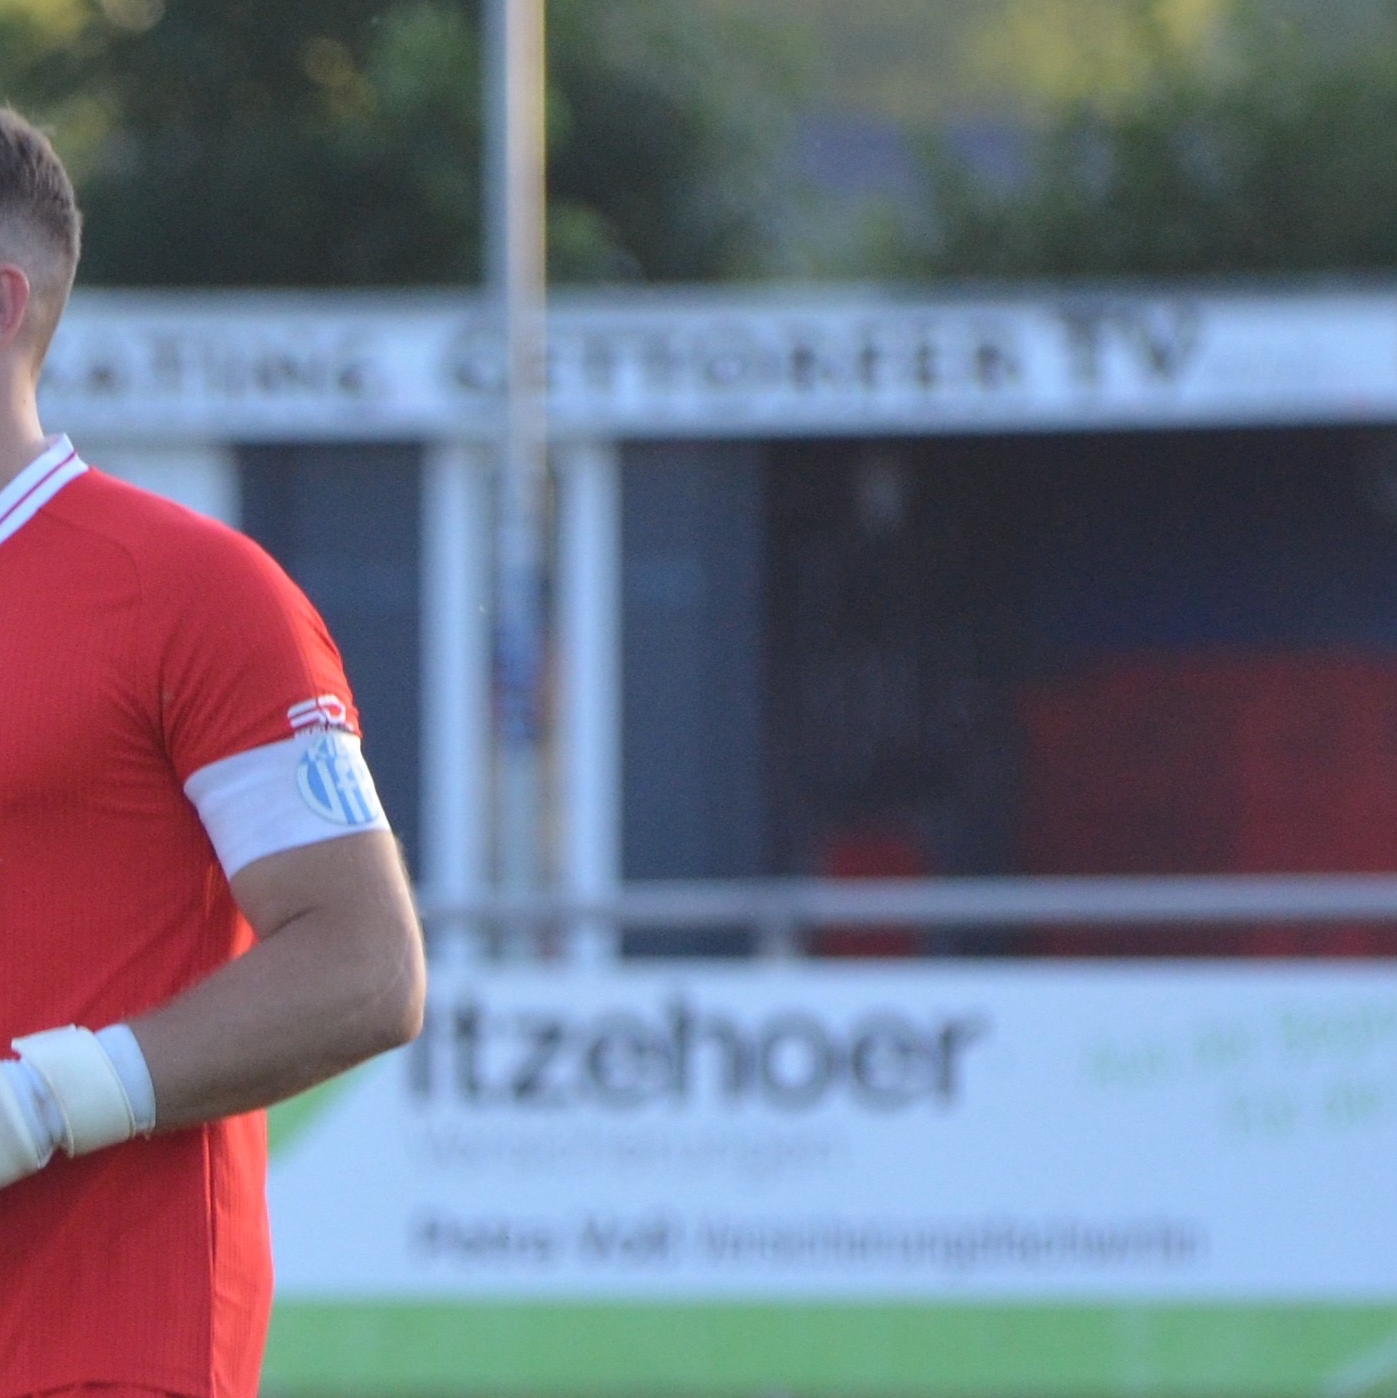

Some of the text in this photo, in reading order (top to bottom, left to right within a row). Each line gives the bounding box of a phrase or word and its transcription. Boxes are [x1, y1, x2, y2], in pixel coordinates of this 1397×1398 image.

[450, 308, 1022, 392] GTTORFER
[1050, 298, 1204, 384] TV
[407, 996, 988, 1114] Itzehoer
